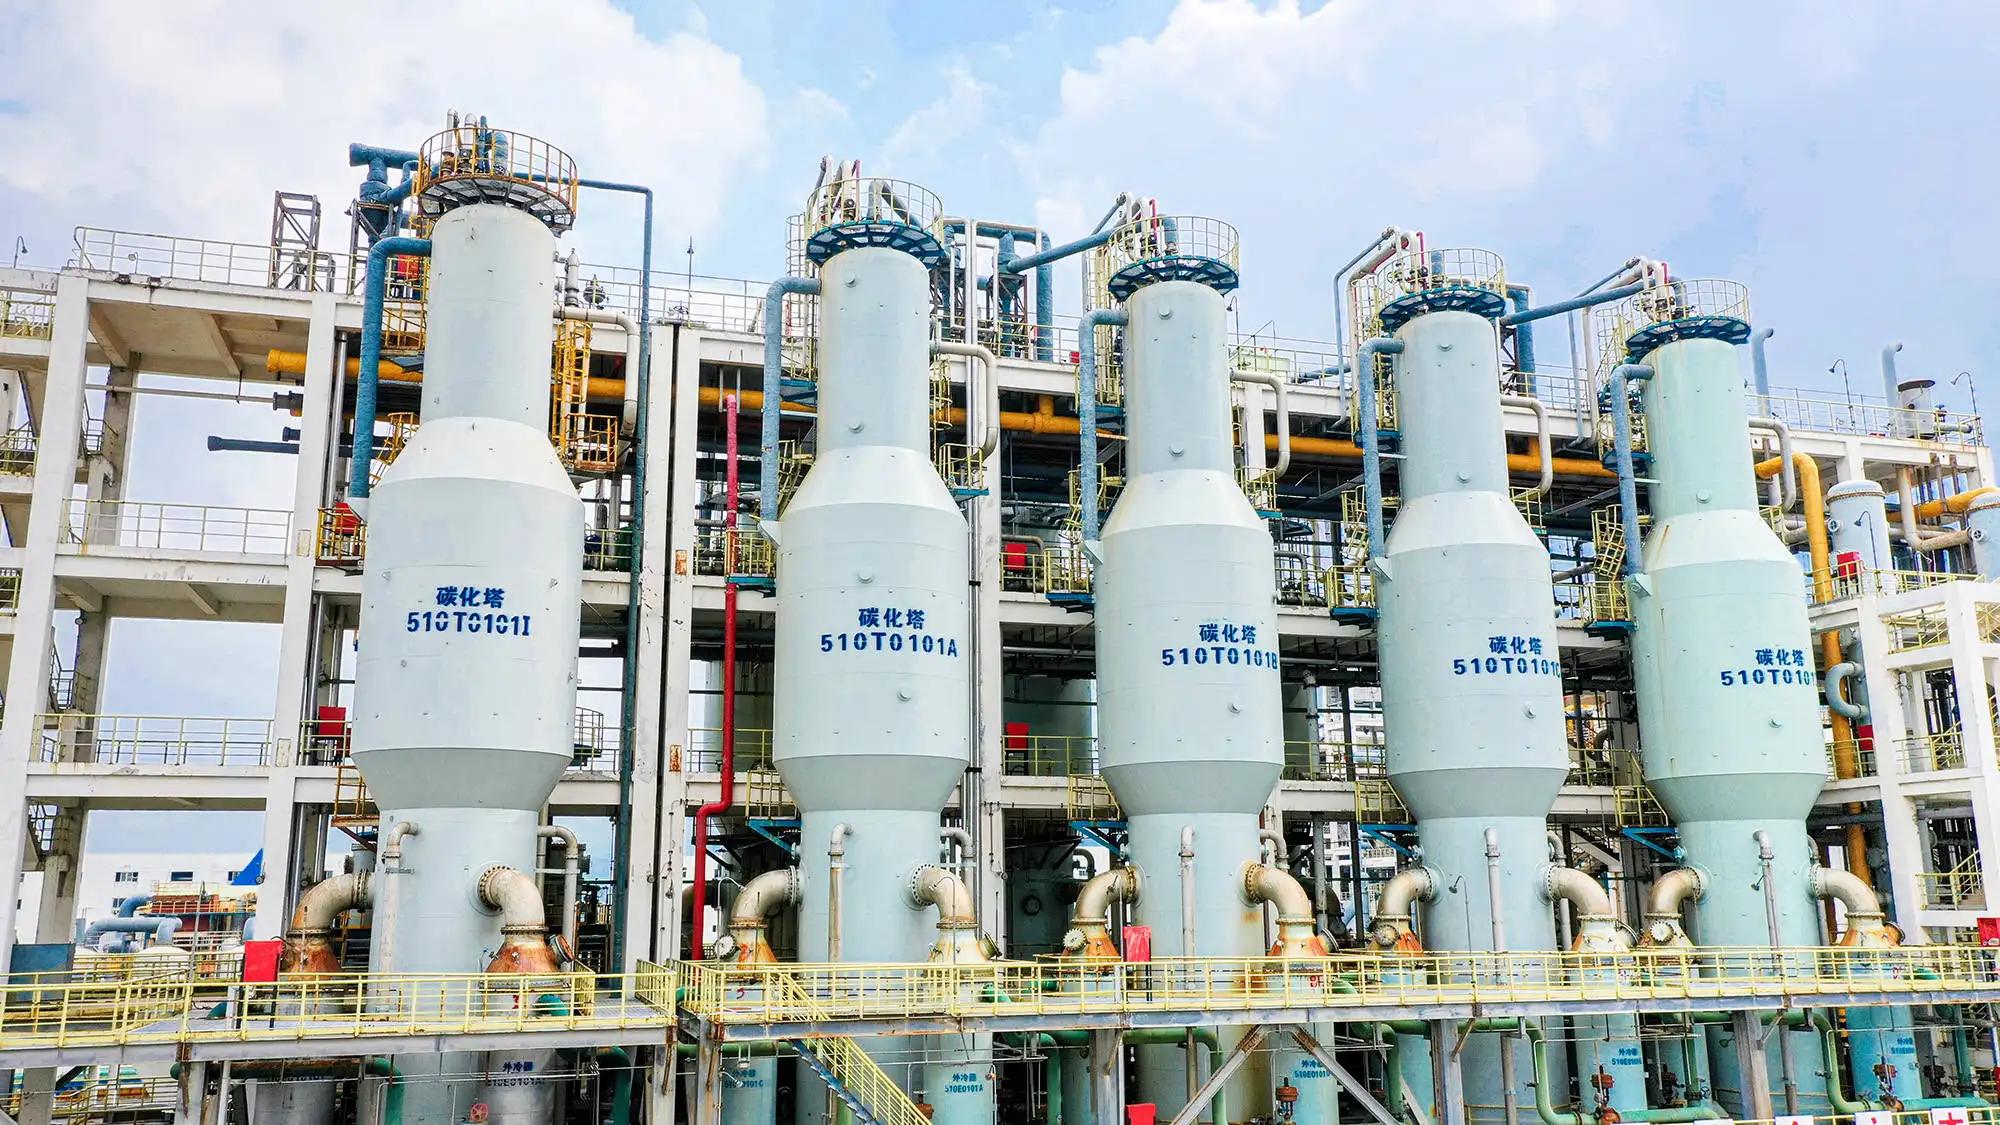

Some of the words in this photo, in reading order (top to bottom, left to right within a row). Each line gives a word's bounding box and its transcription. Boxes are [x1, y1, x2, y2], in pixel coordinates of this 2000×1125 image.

[435, 585, 505, 609] 碳化塔
[407, 611, 531, 636] 510T0101I
[858, 607, 925, 630] 碳化塔
[820, 632, 958, 657] 510T0101A
[1199, 623, 1256, 645] 碳化塔
[1488, 636, 1543, 655] 碳化塔
[1162, 647, 1278, 670] 510T0101B
[1754, 648, 1804, 667] 碳化塔
